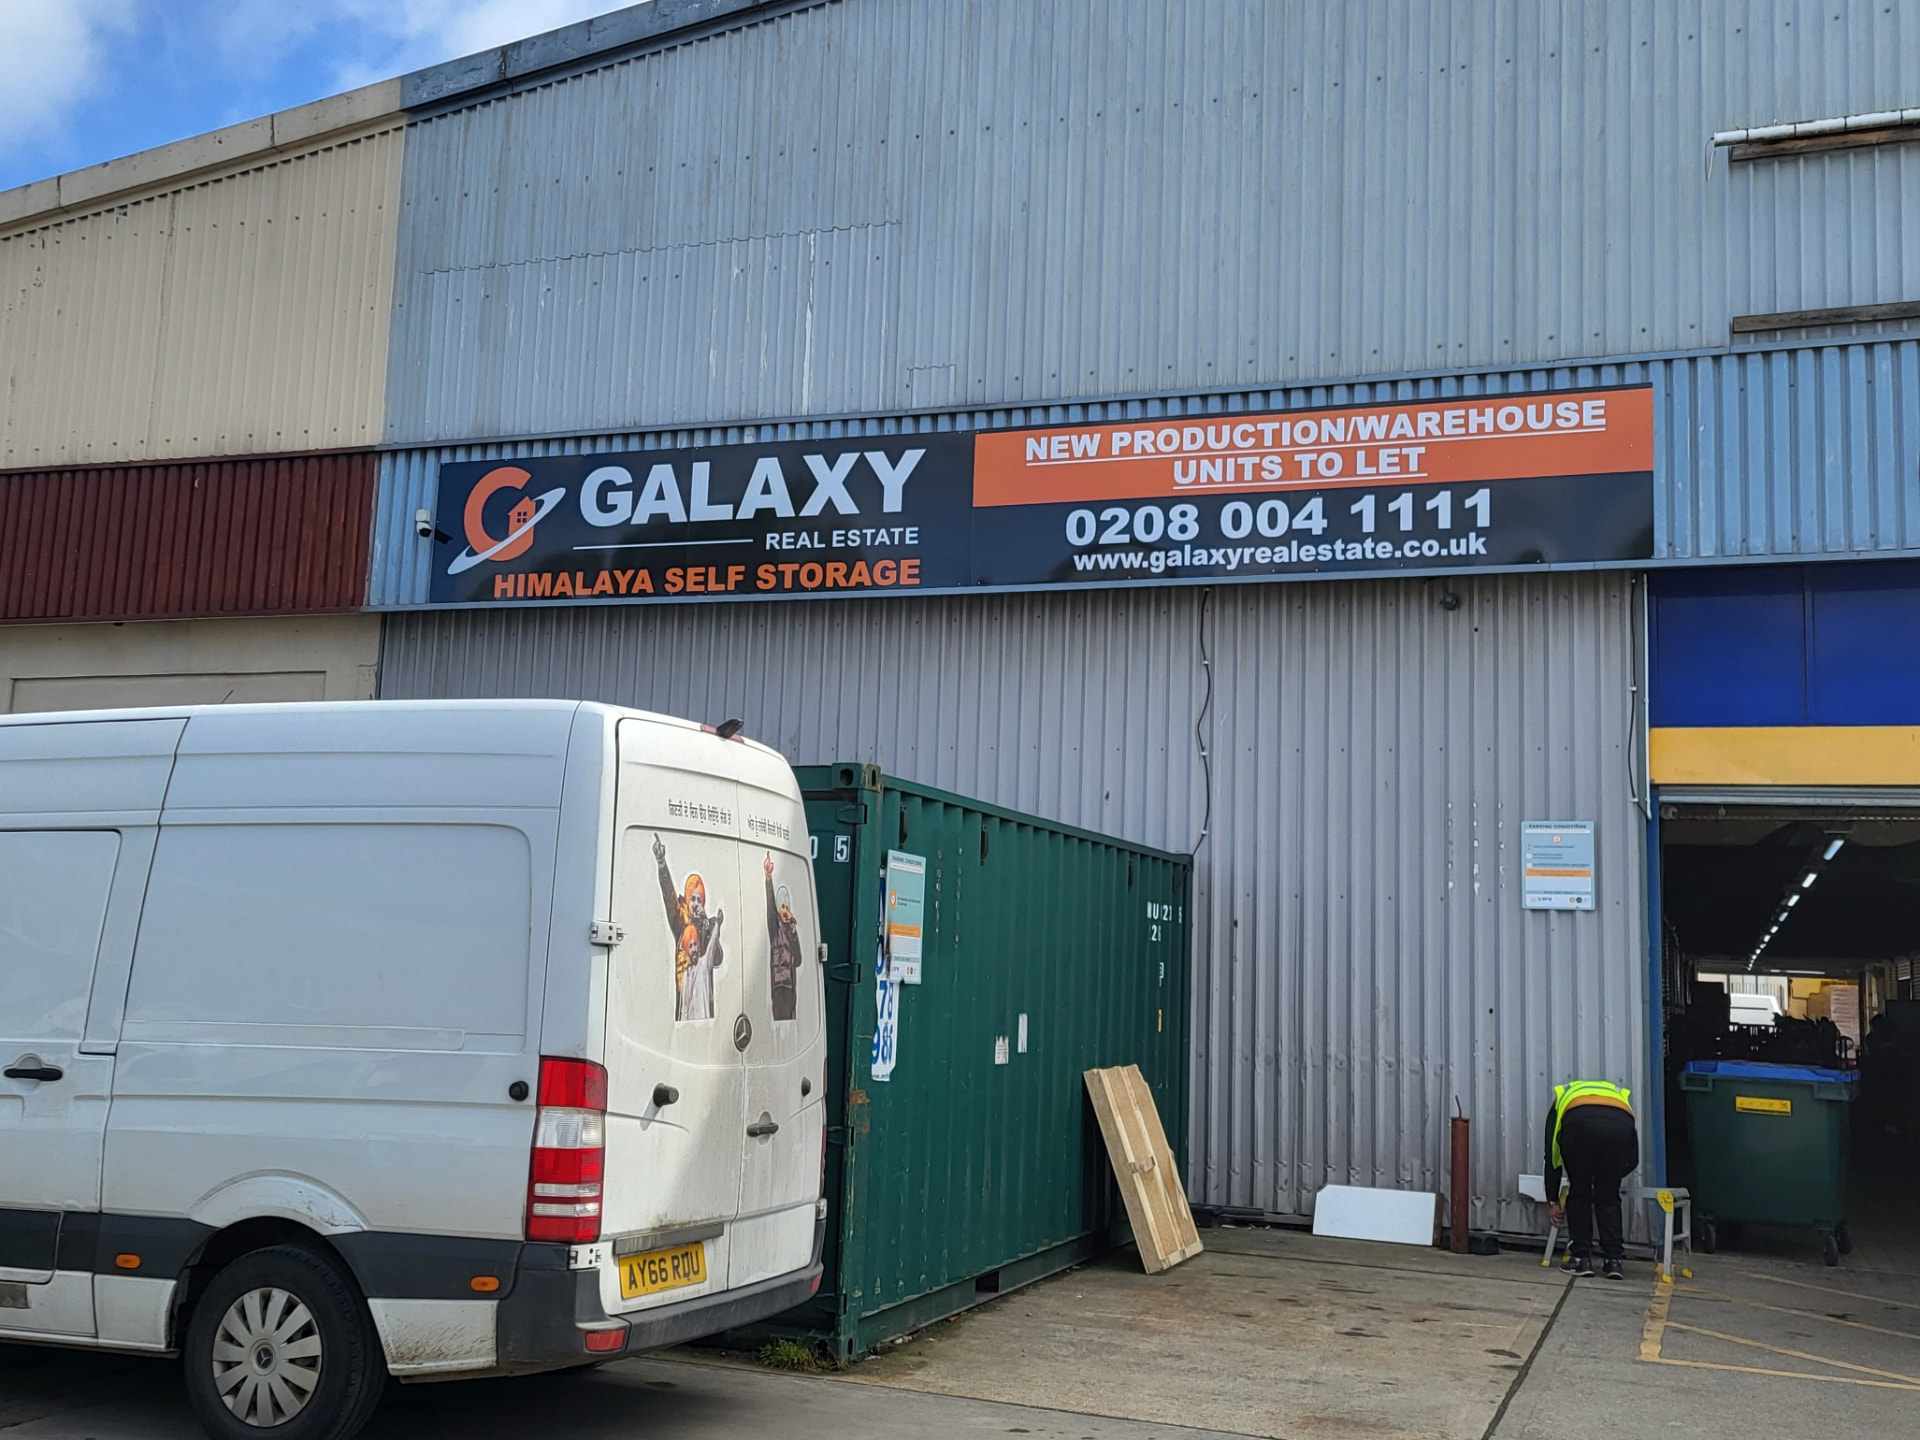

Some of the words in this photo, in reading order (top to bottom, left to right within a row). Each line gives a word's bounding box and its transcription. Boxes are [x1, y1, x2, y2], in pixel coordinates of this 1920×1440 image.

[1025, 432, 1102, 461] NEW
[1111, 399, 1607, 456] PRODUCTION/WAREHOUSE
[1173, 454, 1283, 485] UNITS
[1293, 451, 1343, 479] TO
[1356, 446, 1426, 475] LET
[579, 448, 926, 528] GALAXY
[1065, 504, 1200, 546] 0208
[1220, 497, 1328, 539] 004
[1350, 488, 1491, 533] 1111
[765, 531, 826, 551] REAL
[832, 527, 919, 548] ESTATE
[1073, 532, 1488, 574] www.galaxyrealestate.co.uk
[493, 569, 654, 600] HIMALAYA
[664, 565, 745, 593] SELF
[756, 559, 921, 590] STORAGE
[836, 836, 848, 861] 5
[628, 1257, 669, 1291] AY66
